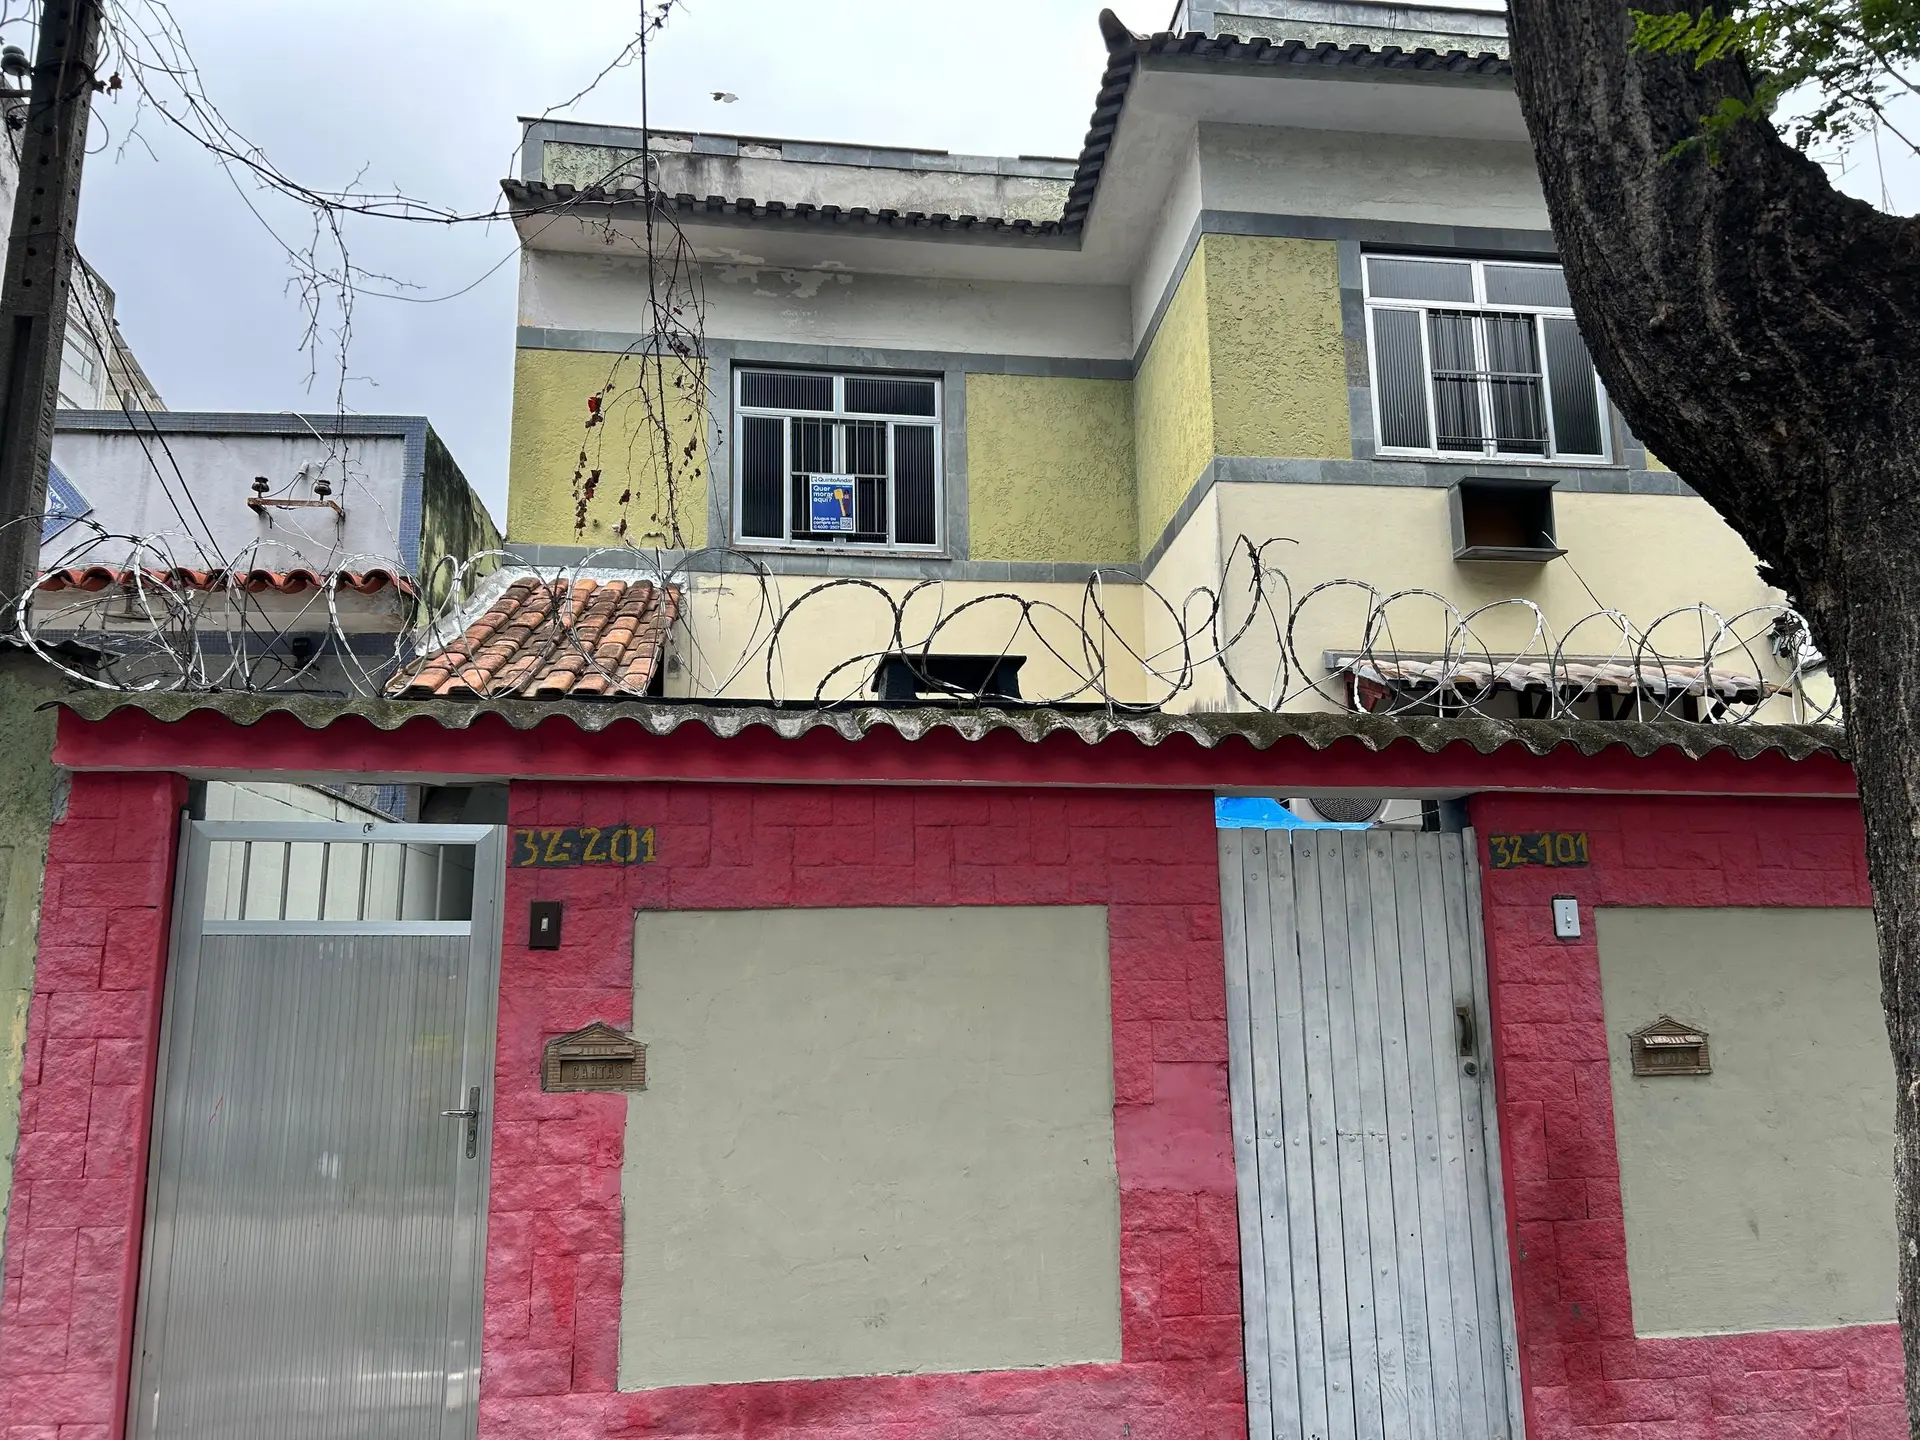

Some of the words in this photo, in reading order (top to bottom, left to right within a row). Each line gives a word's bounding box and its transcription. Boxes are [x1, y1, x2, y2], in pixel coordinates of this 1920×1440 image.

[514, 827, 657, 866] 32-201
[1490, 833, 1589, 868] 32-101
[572, 1063, 623, 1080] CARTAS
